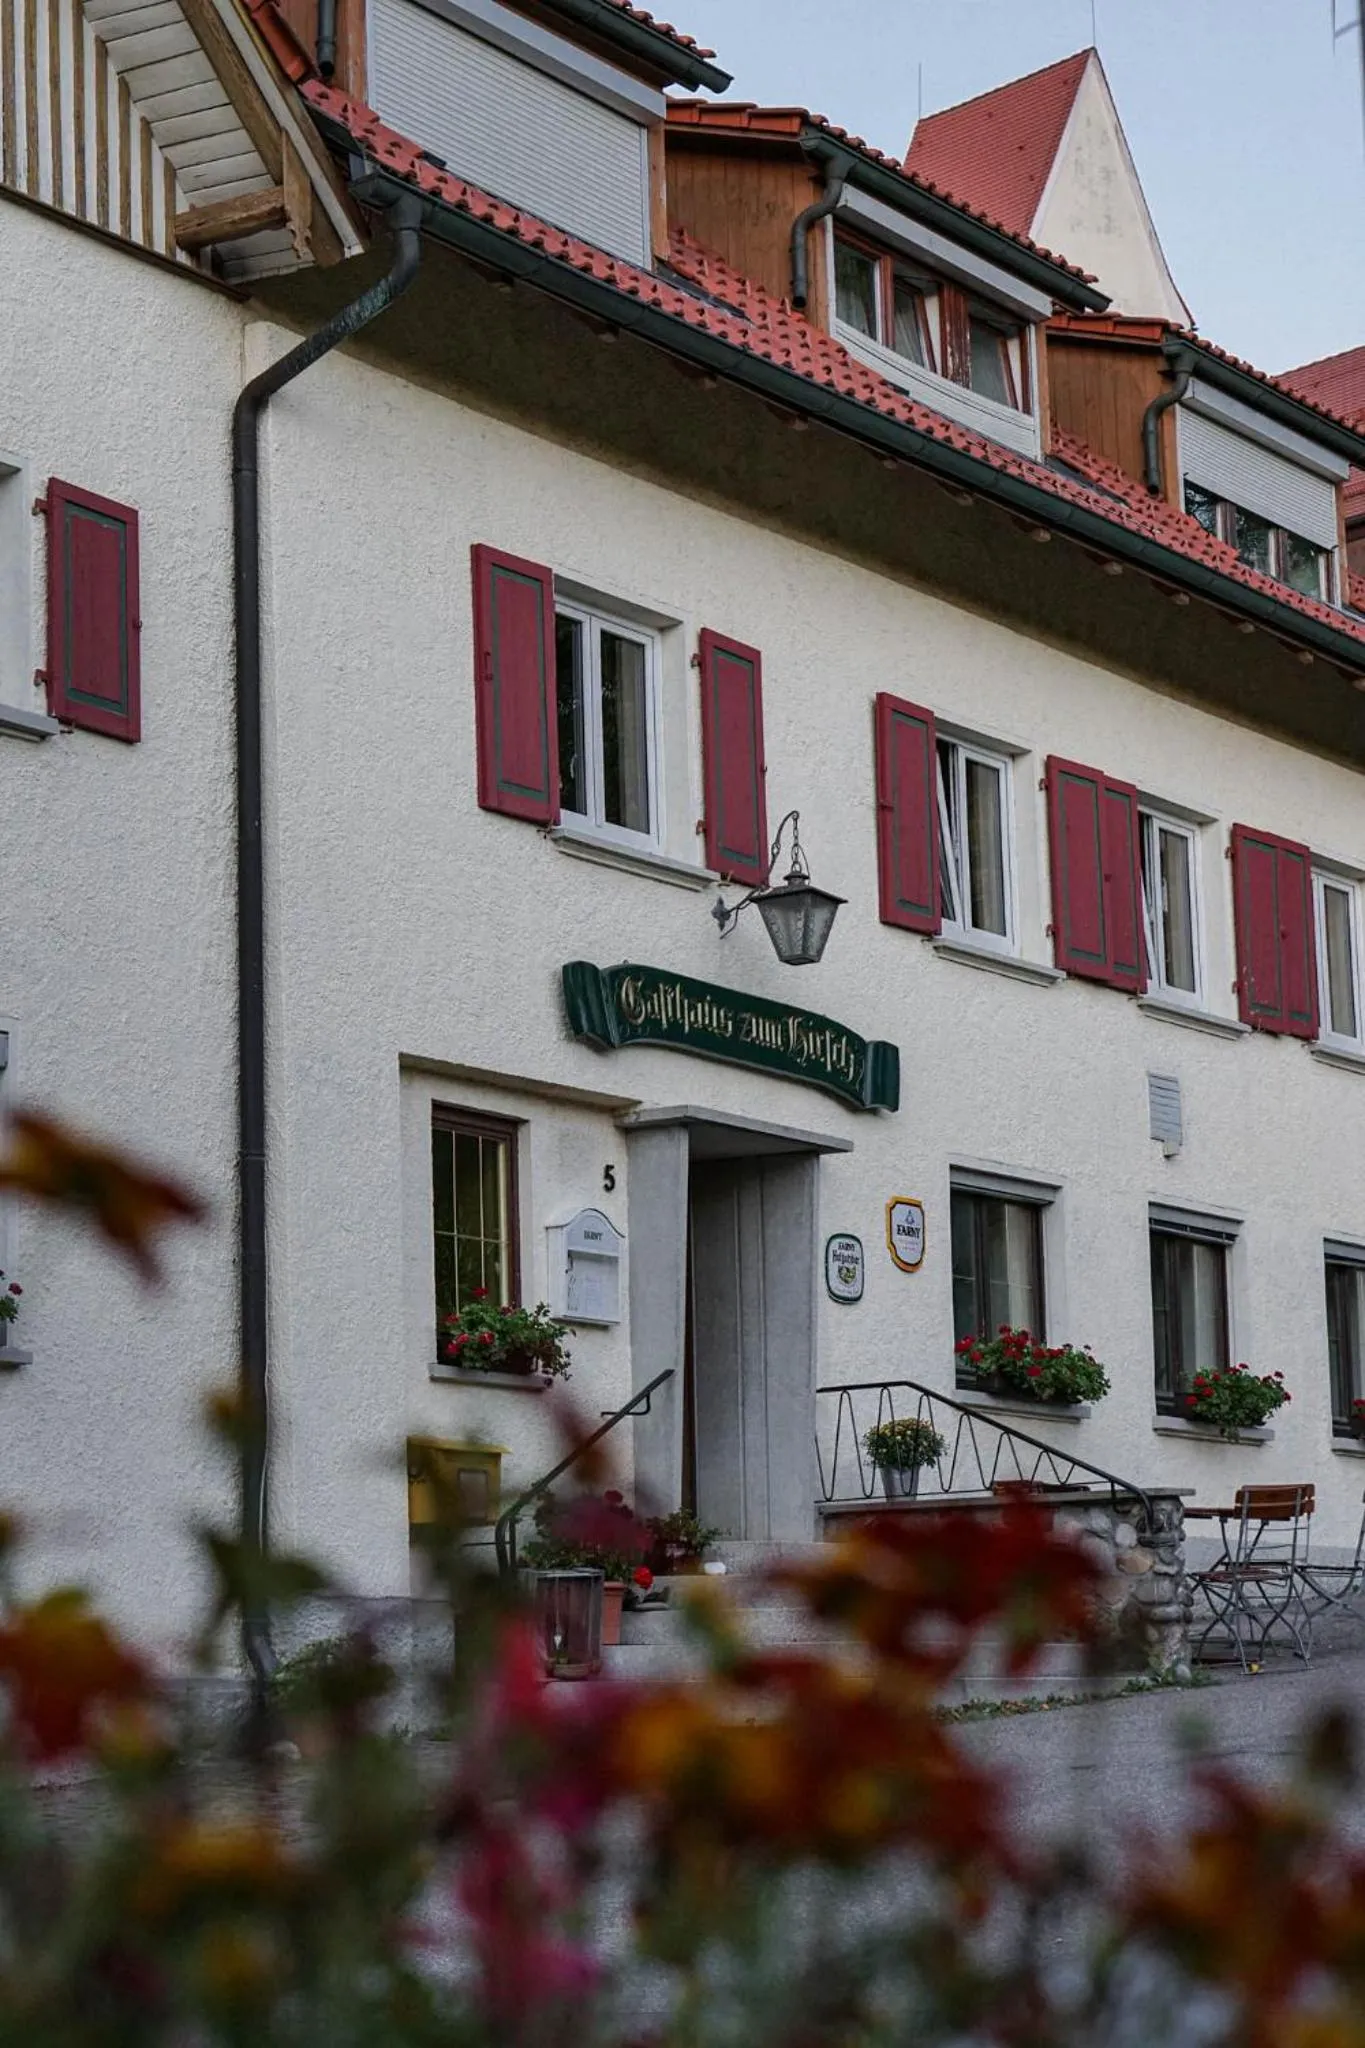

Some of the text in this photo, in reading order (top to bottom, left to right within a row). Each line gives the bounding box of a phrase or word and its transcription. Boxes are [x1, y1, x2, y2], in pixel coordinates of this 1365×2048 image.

[740, 1012, 784, 1051] zum
[602, 1164, 615, 1193] 5
[896, 1224, 921, 1239] FARNY
